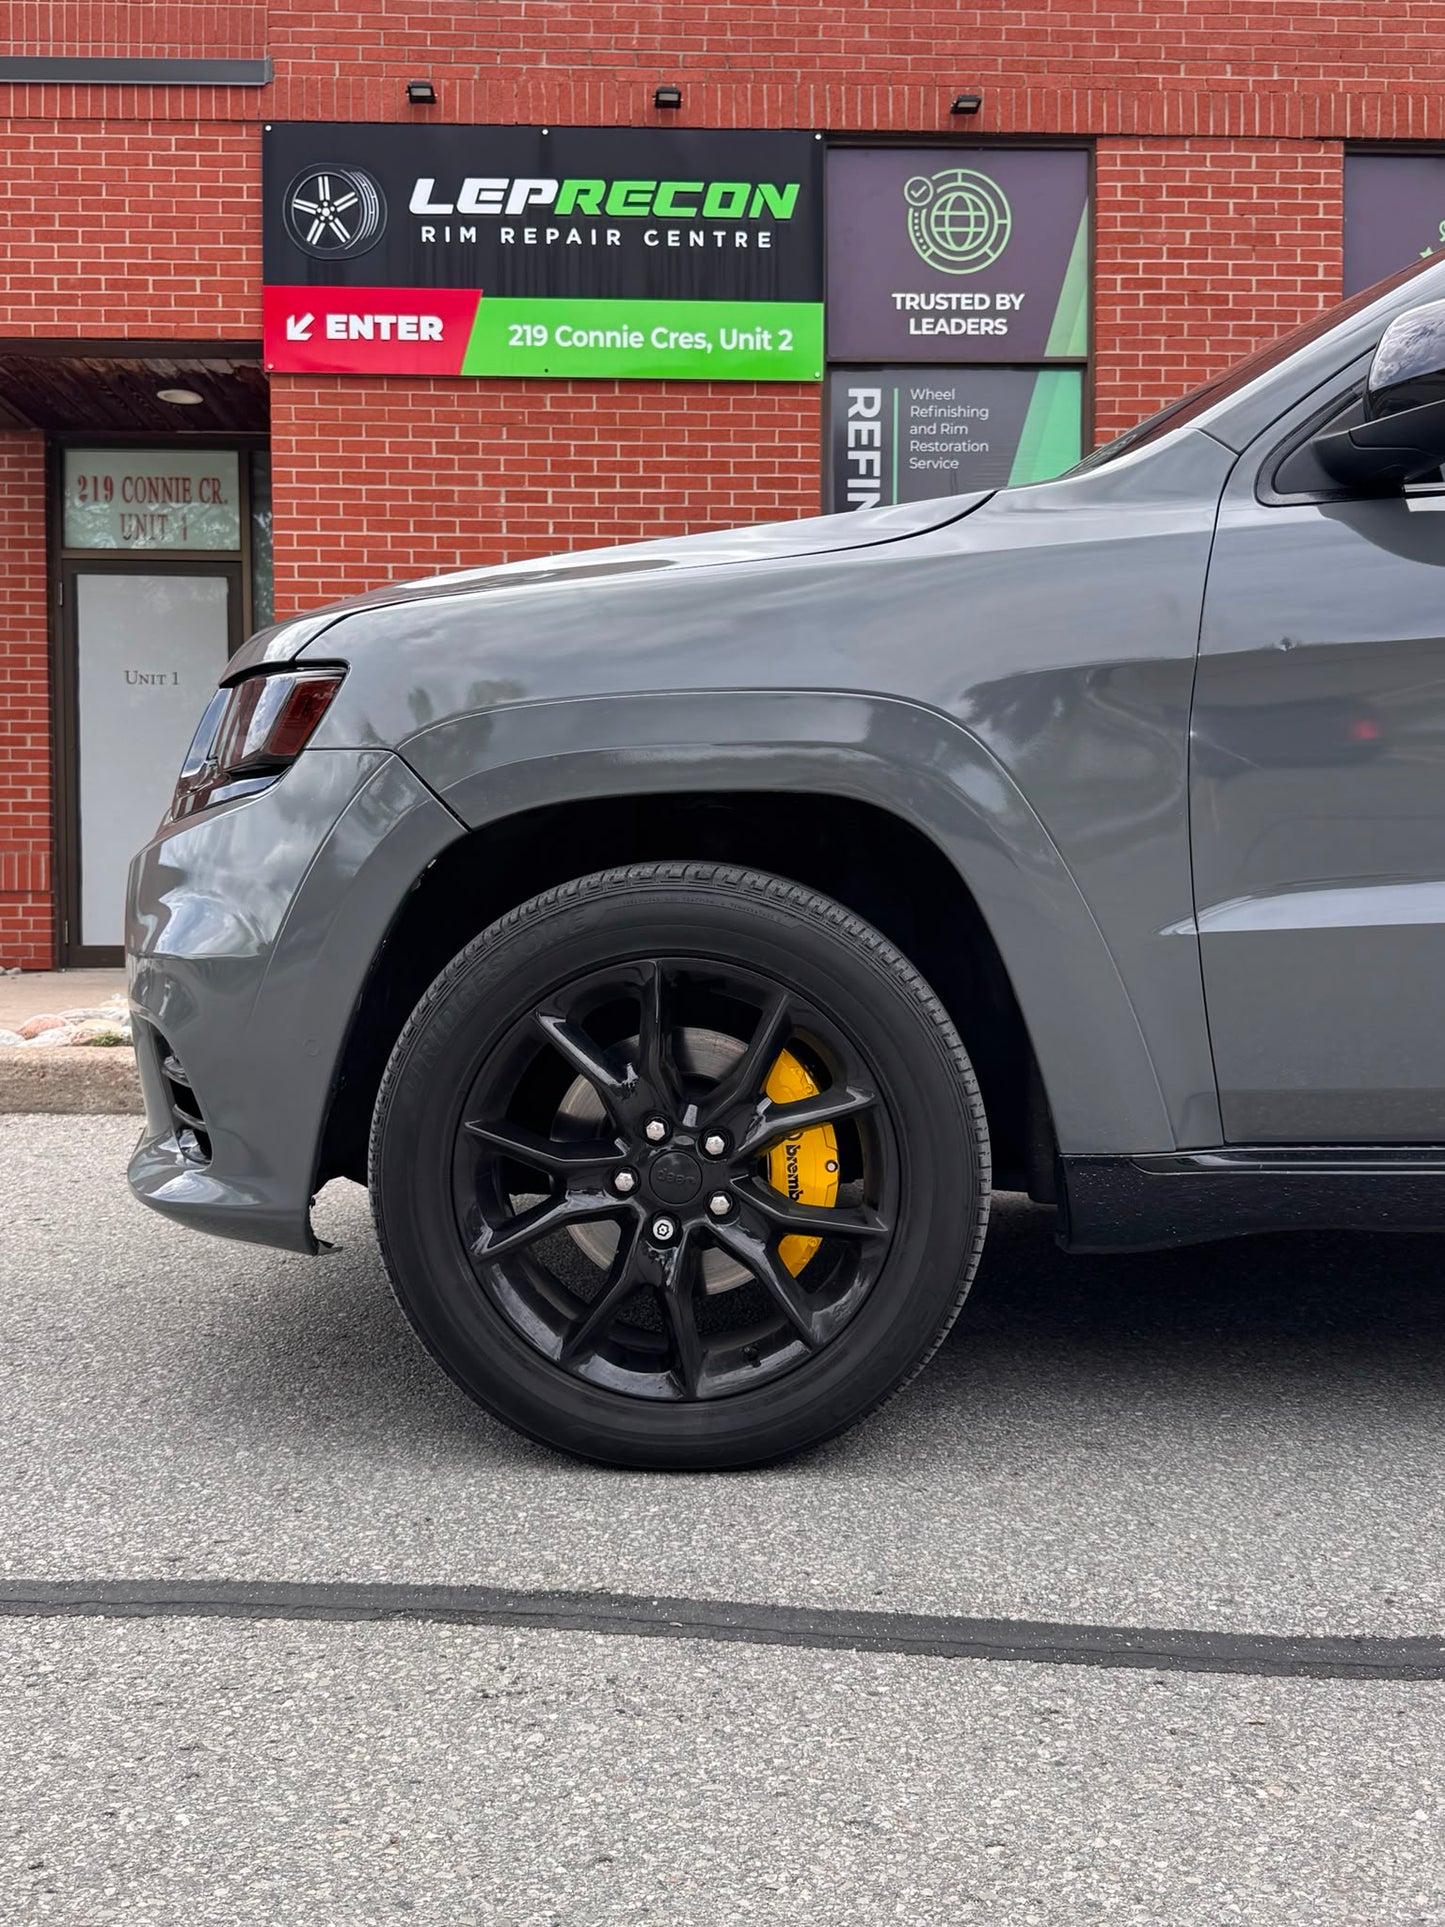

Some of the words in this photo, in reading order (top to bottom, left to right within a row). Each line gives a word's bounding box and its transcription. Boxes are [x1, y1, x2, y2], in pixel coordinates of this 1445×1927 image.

[408, 178, 800, 219] LEPRECON
[421, 226, 476, 243] RIM
[500, 227, 621, 246] REPAIR
[643, 230, 772, 248] CENTRE
[891, 293, 991, 310] TRUSTED
[995, 294, 1025, 310] BY
[326, 314, 444, 342] ENTER
[909, 317, 1008, 335] LEADERS
[508, 324, 549, 347] 219
[554, 324, 645, 349] Connie
[650, 326, 713, 354] Cres,
[719, 327, 773, 351] Unit
[777, 329, 794, 351] 2
[910, 388, 956, 401] Wheel
[910, 405, 989, 420] Refinishing
[909, 423, 937, 435] and
[940, 423, 969, 435] Rim
[910, 440, 989, 452] Restoration
[909, 457, 960, 470] Service
[77, 474, 115, 503] 219
[121, 475, 193, 505] CONNIE
[197, 477, 229, 505] CR.
[120, 513, 169, 541] UNIT
[171, 671, 179, 686] 1
